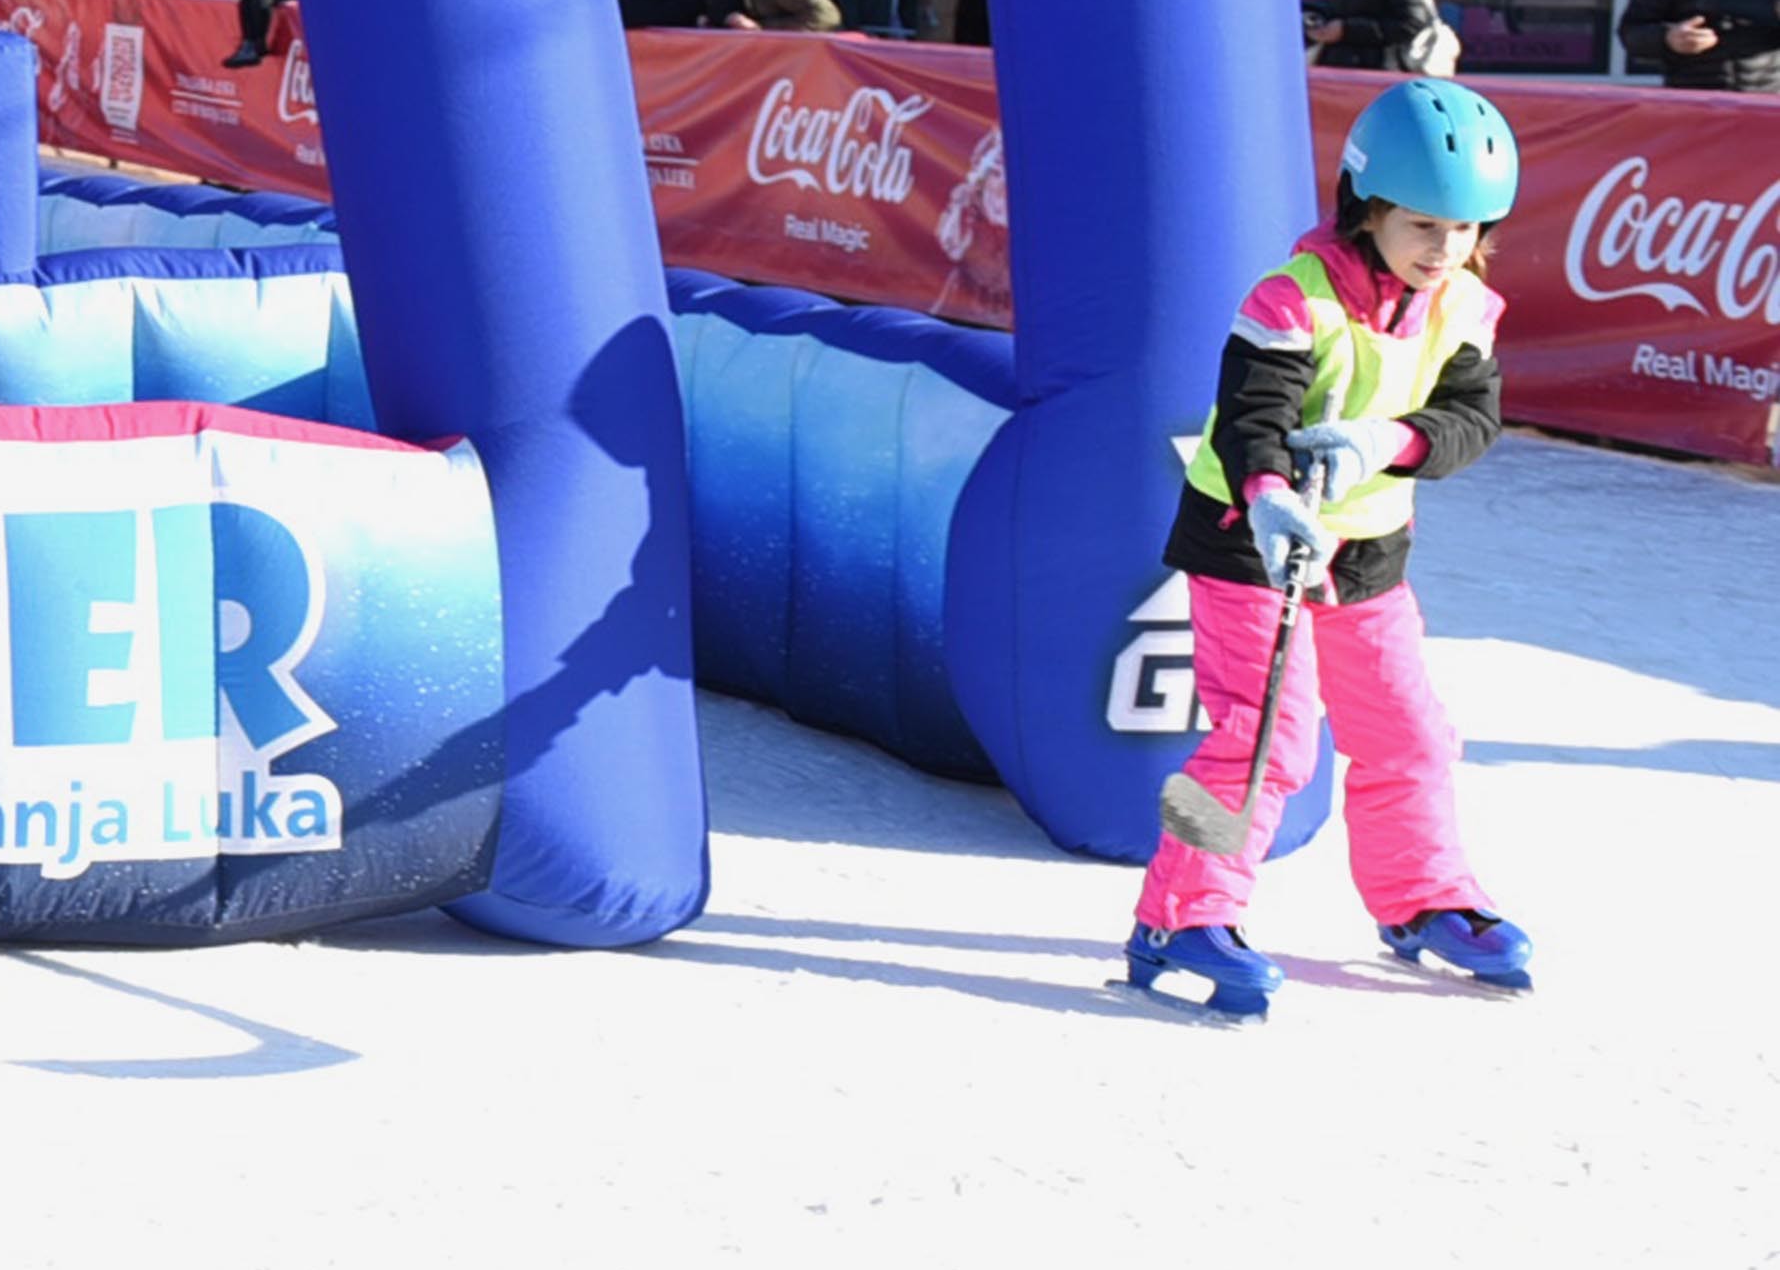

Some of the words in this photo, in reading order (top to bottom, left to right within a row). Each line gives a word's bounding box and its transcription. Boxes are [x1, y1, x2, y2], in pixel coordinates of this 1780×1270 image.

[747, 78, 934, 203] Coca-Cola
[1632, 343, 1698, 382] Real
[161, 772, 330, 844] Luka
